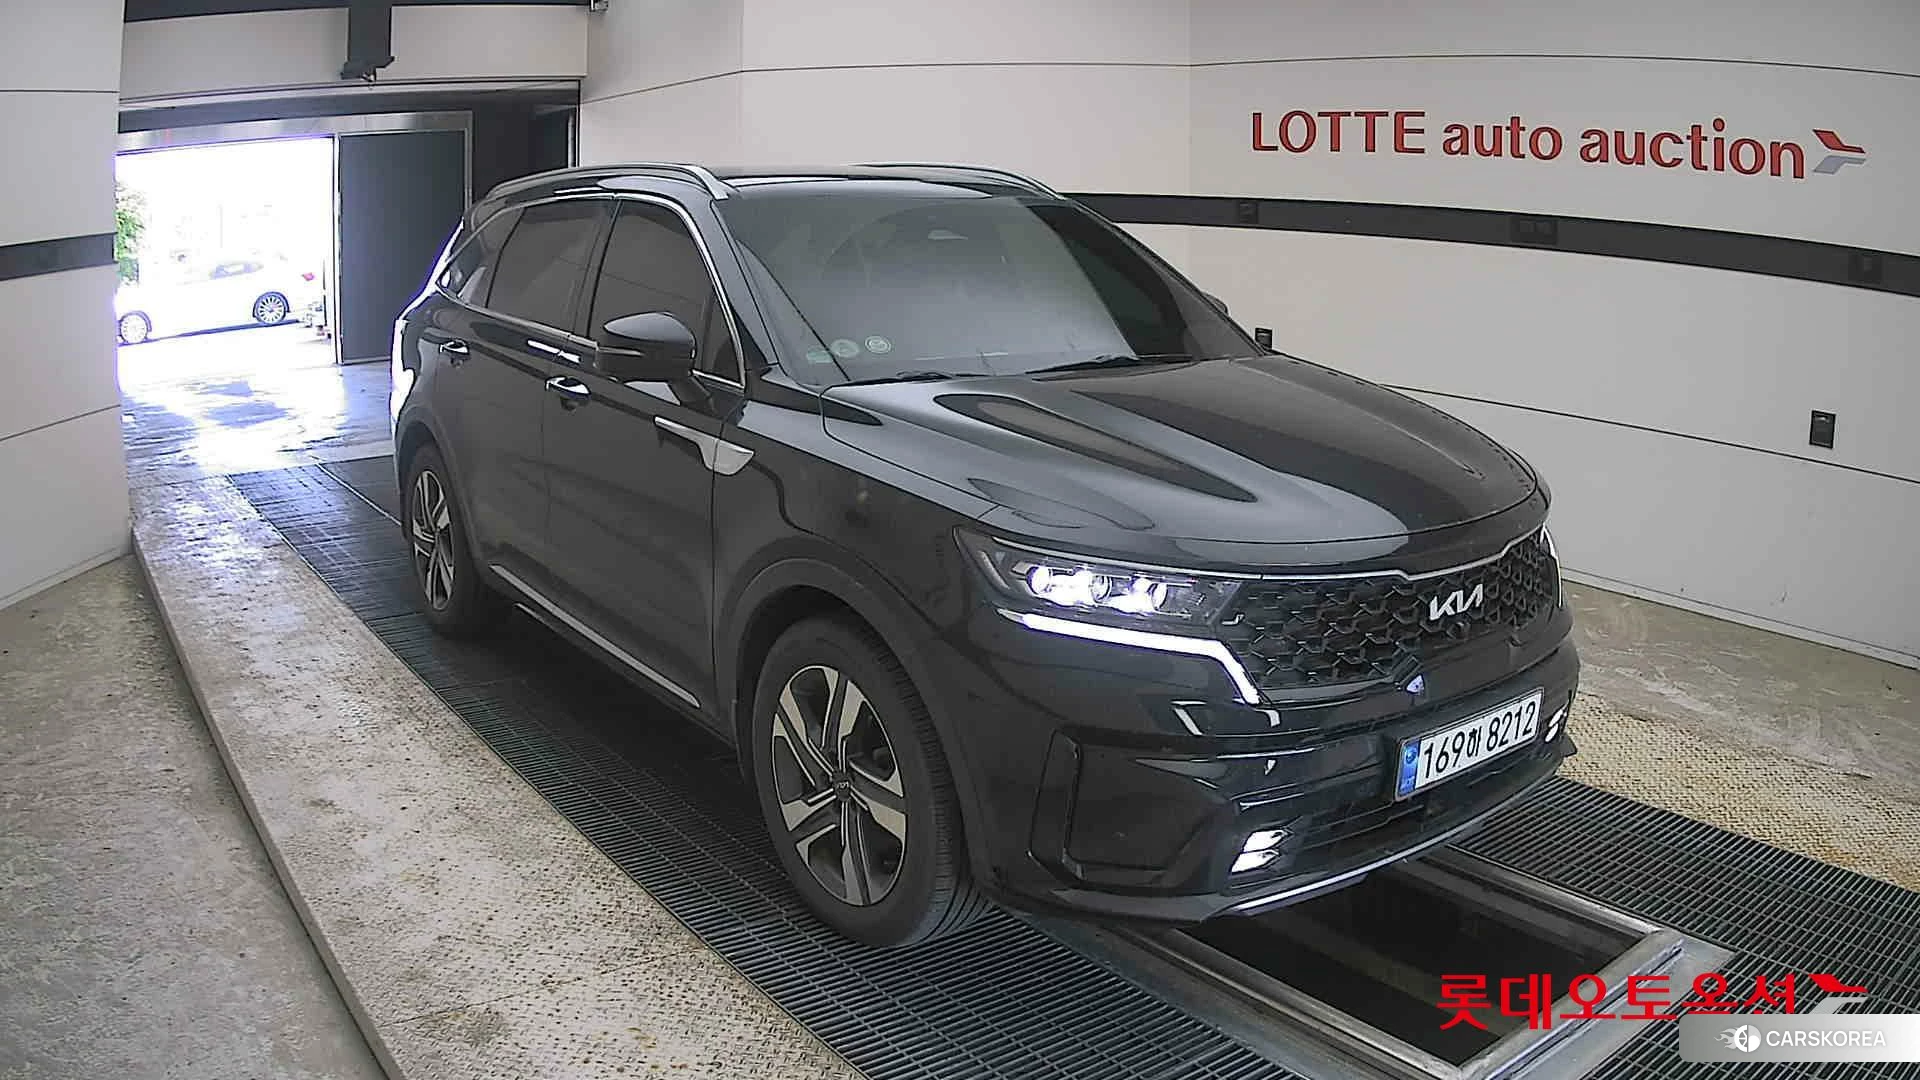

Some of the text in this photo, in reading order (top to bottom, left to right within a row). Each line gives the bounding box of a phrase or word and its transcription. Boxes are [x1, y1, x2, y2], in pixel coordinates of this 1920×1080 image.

[1252, 110, 1805, 178] LOTTE auto auction
[1424, 701, 1537, 778] 169하 8212
